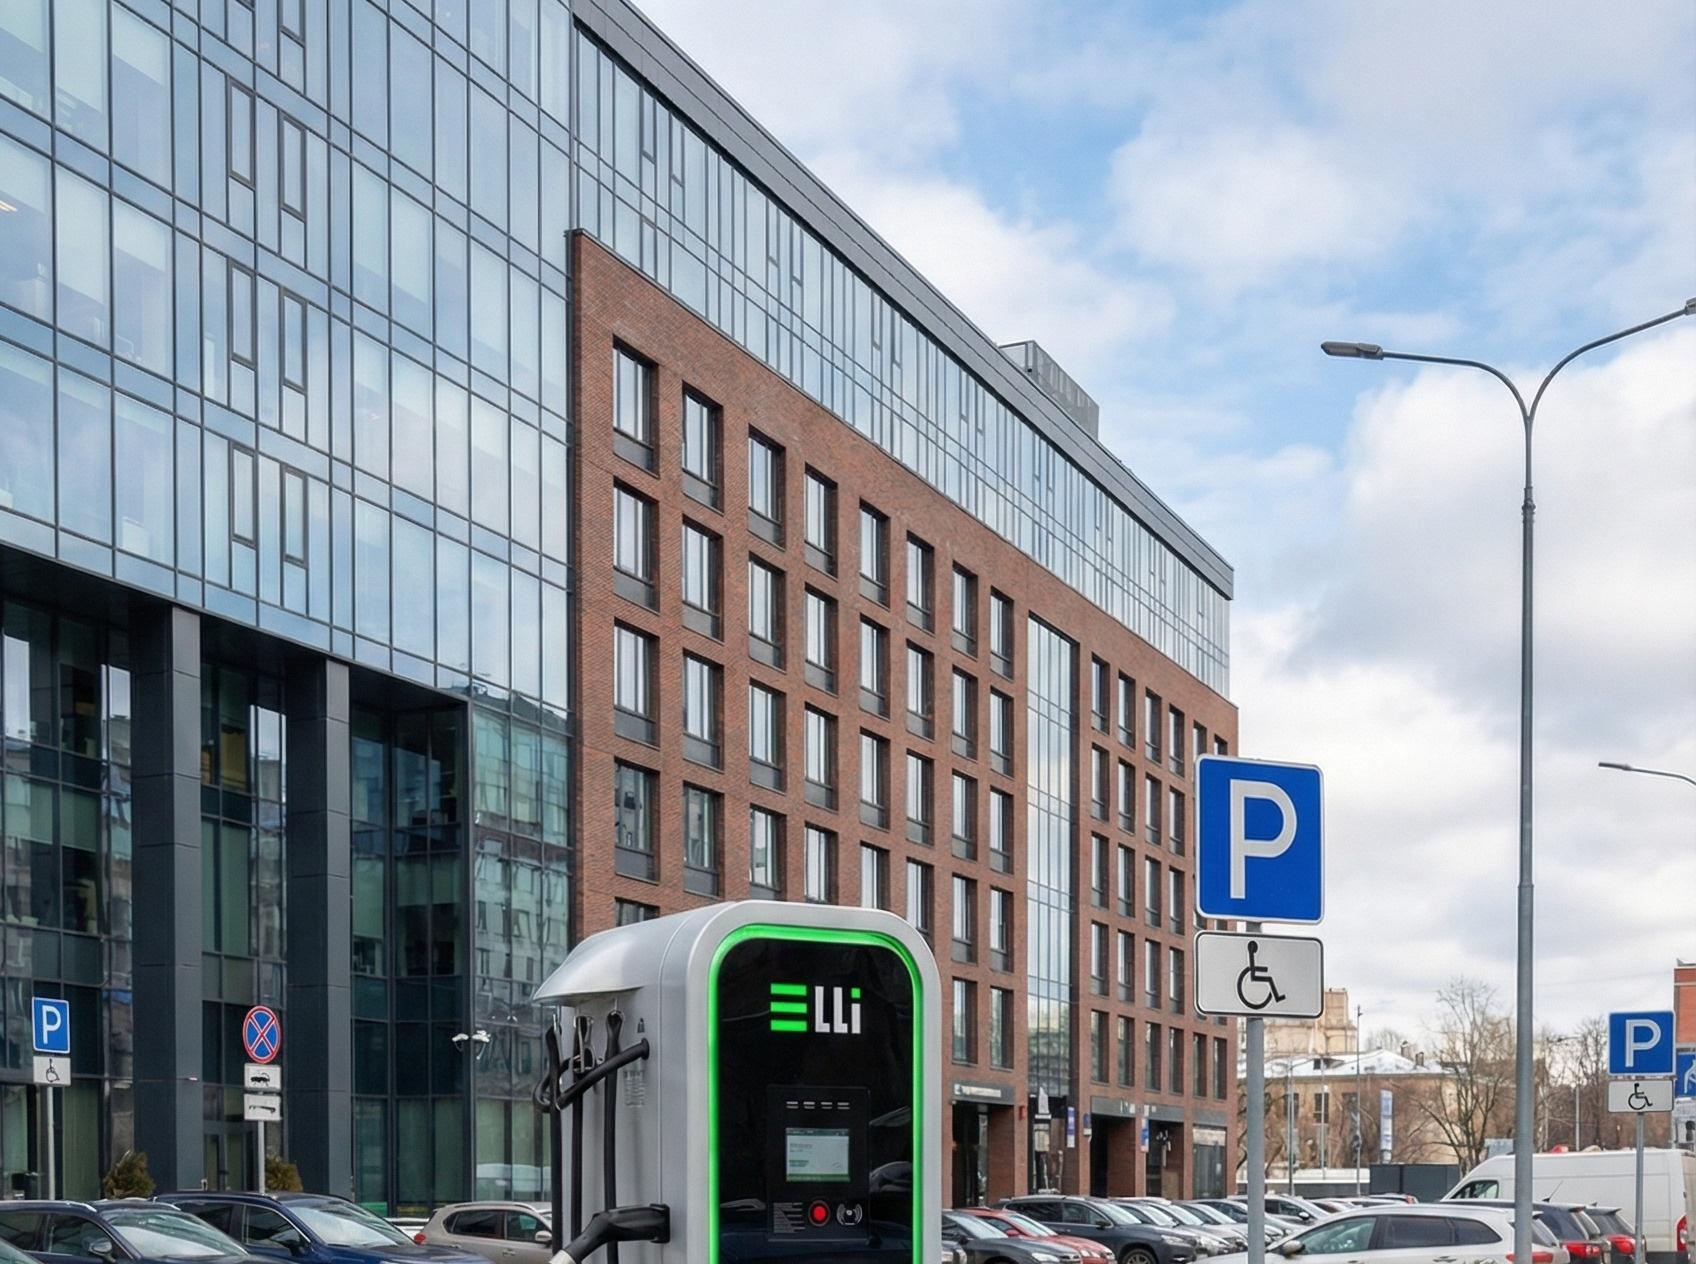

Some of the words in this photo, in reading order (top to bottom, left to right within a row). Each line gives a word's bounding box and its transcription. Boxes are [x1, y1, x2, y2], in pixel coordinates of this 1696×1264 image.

[1230, 779, 1297, 899] P
[42, 1005, 61, 1044] P
[1625, 1019, 1661, 1067] P
